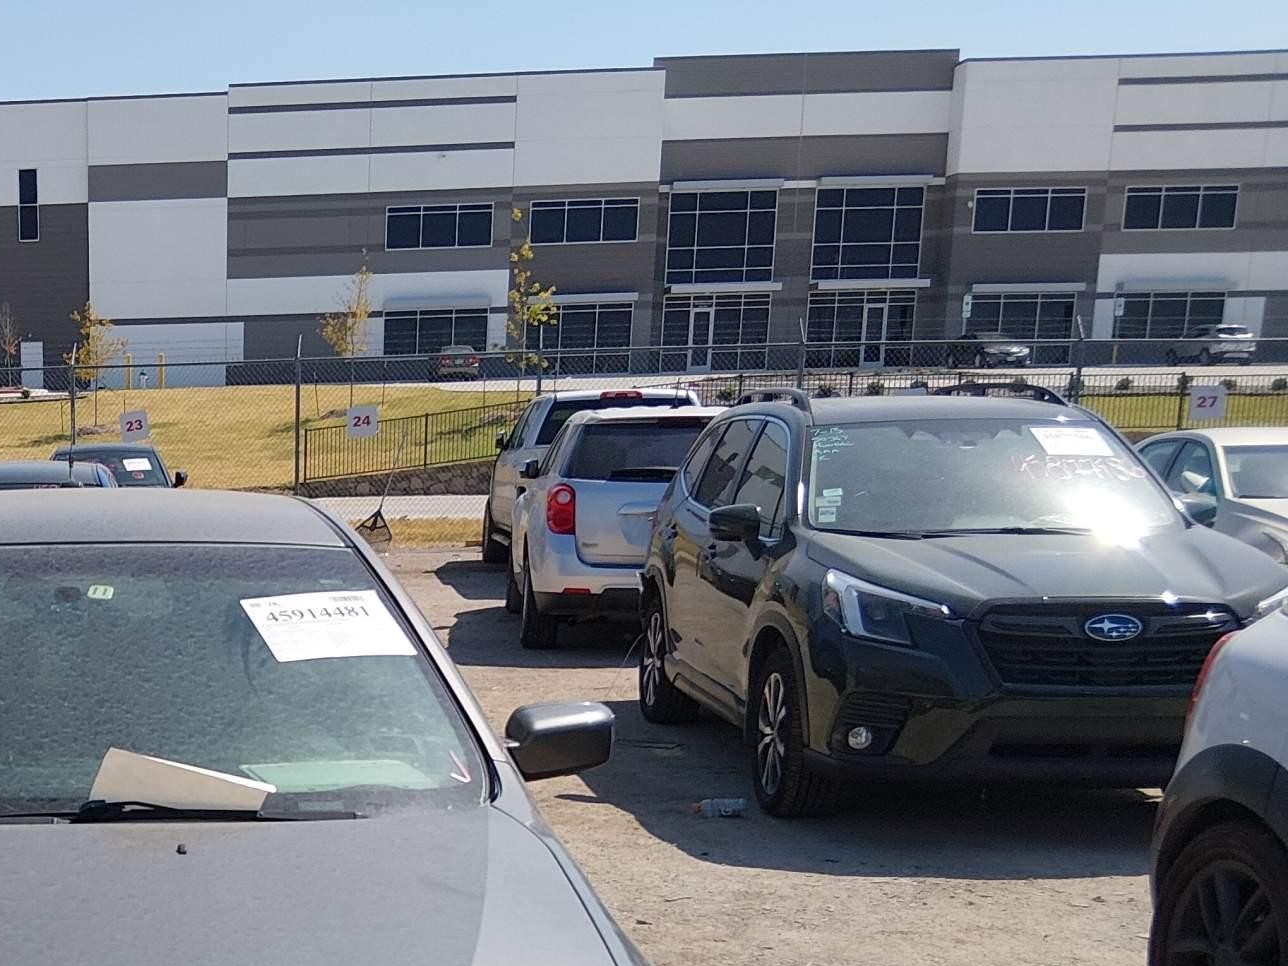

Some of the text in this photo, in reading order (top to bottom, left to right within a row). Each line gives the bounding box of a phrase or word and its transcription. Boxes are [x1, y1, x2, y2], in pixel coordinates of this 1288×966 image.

[1197, 396, 1217, 408] 27
[126, 420, 143, 432] 23
[353, 416, 371, 427] 24
[266, 605, 370, 622] 45914481
